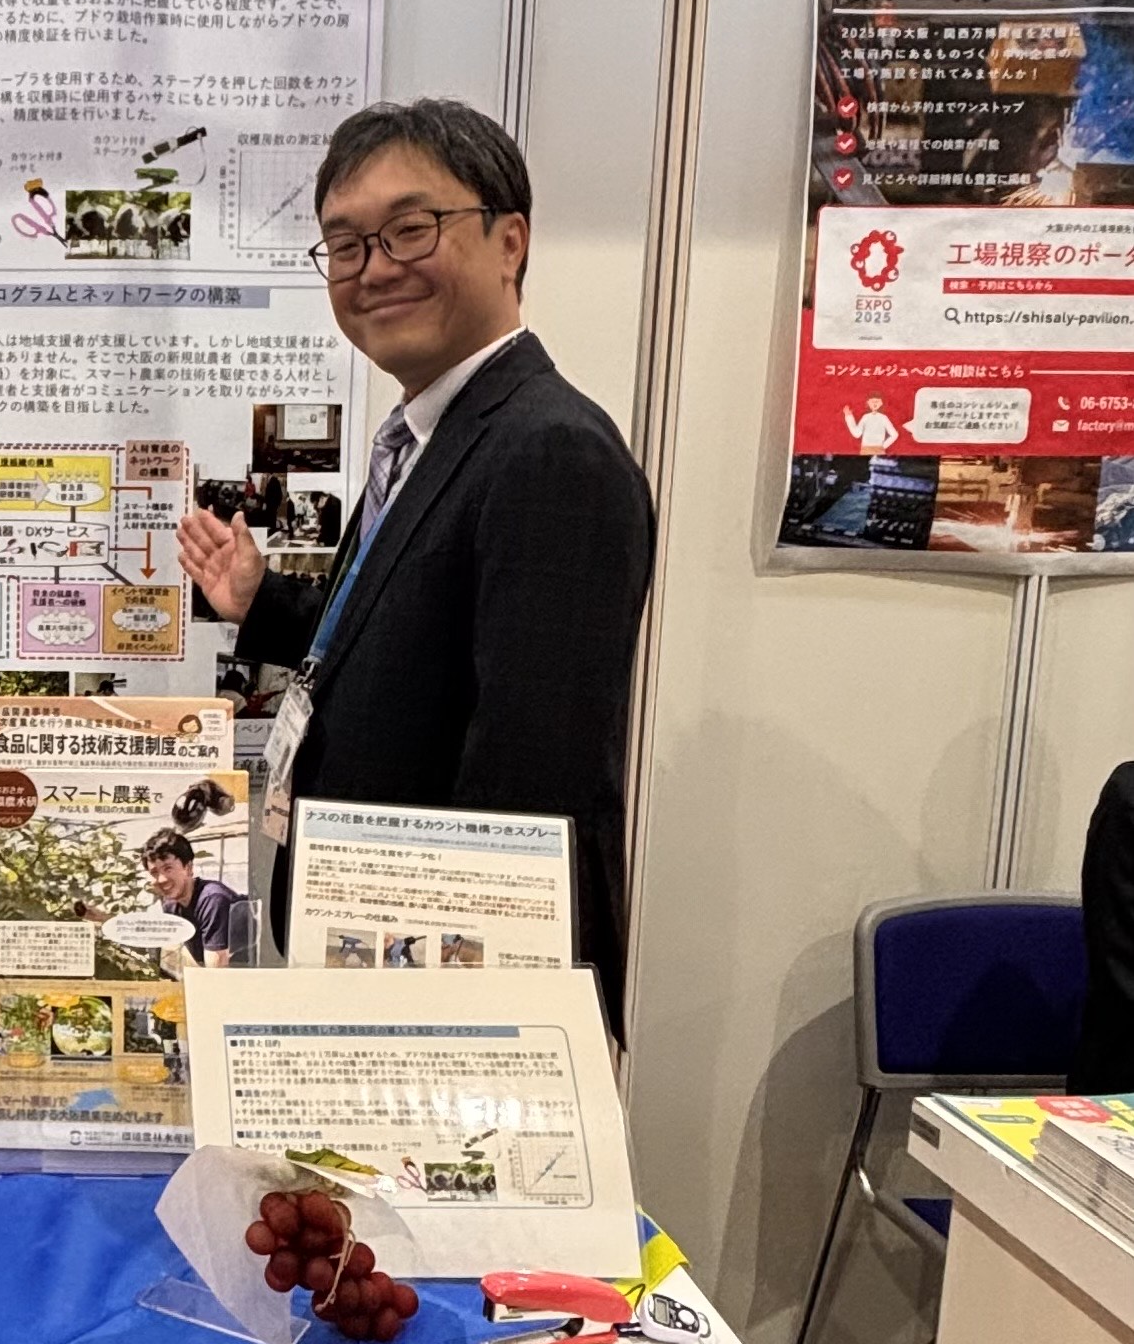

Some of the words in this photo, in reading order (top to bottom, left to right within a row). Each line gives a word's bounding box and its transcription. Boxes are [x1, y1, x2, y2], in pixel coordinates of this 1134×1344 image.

[840, 68, 1038, 81] 工場や施設を訪れてみませんか！
[866, 100, 1025, 114] 検索から予約までワンストップ
[855, 299, 893, 311] EXPO
[854, 311, 892, 324] 2025
[824, 363, 1025, 378] コンシェルジュへのご相談はこちら
[130, 444, 180, 454] 人材育成の
[130, 456, 180, 466] ネットワーク
[139, 467, 169, 478] の構築
[43, 785, 164, 804] スマート農業で
[306, 810, 561, 838] ナスの花数を把握するカウント機構つきスプレー
